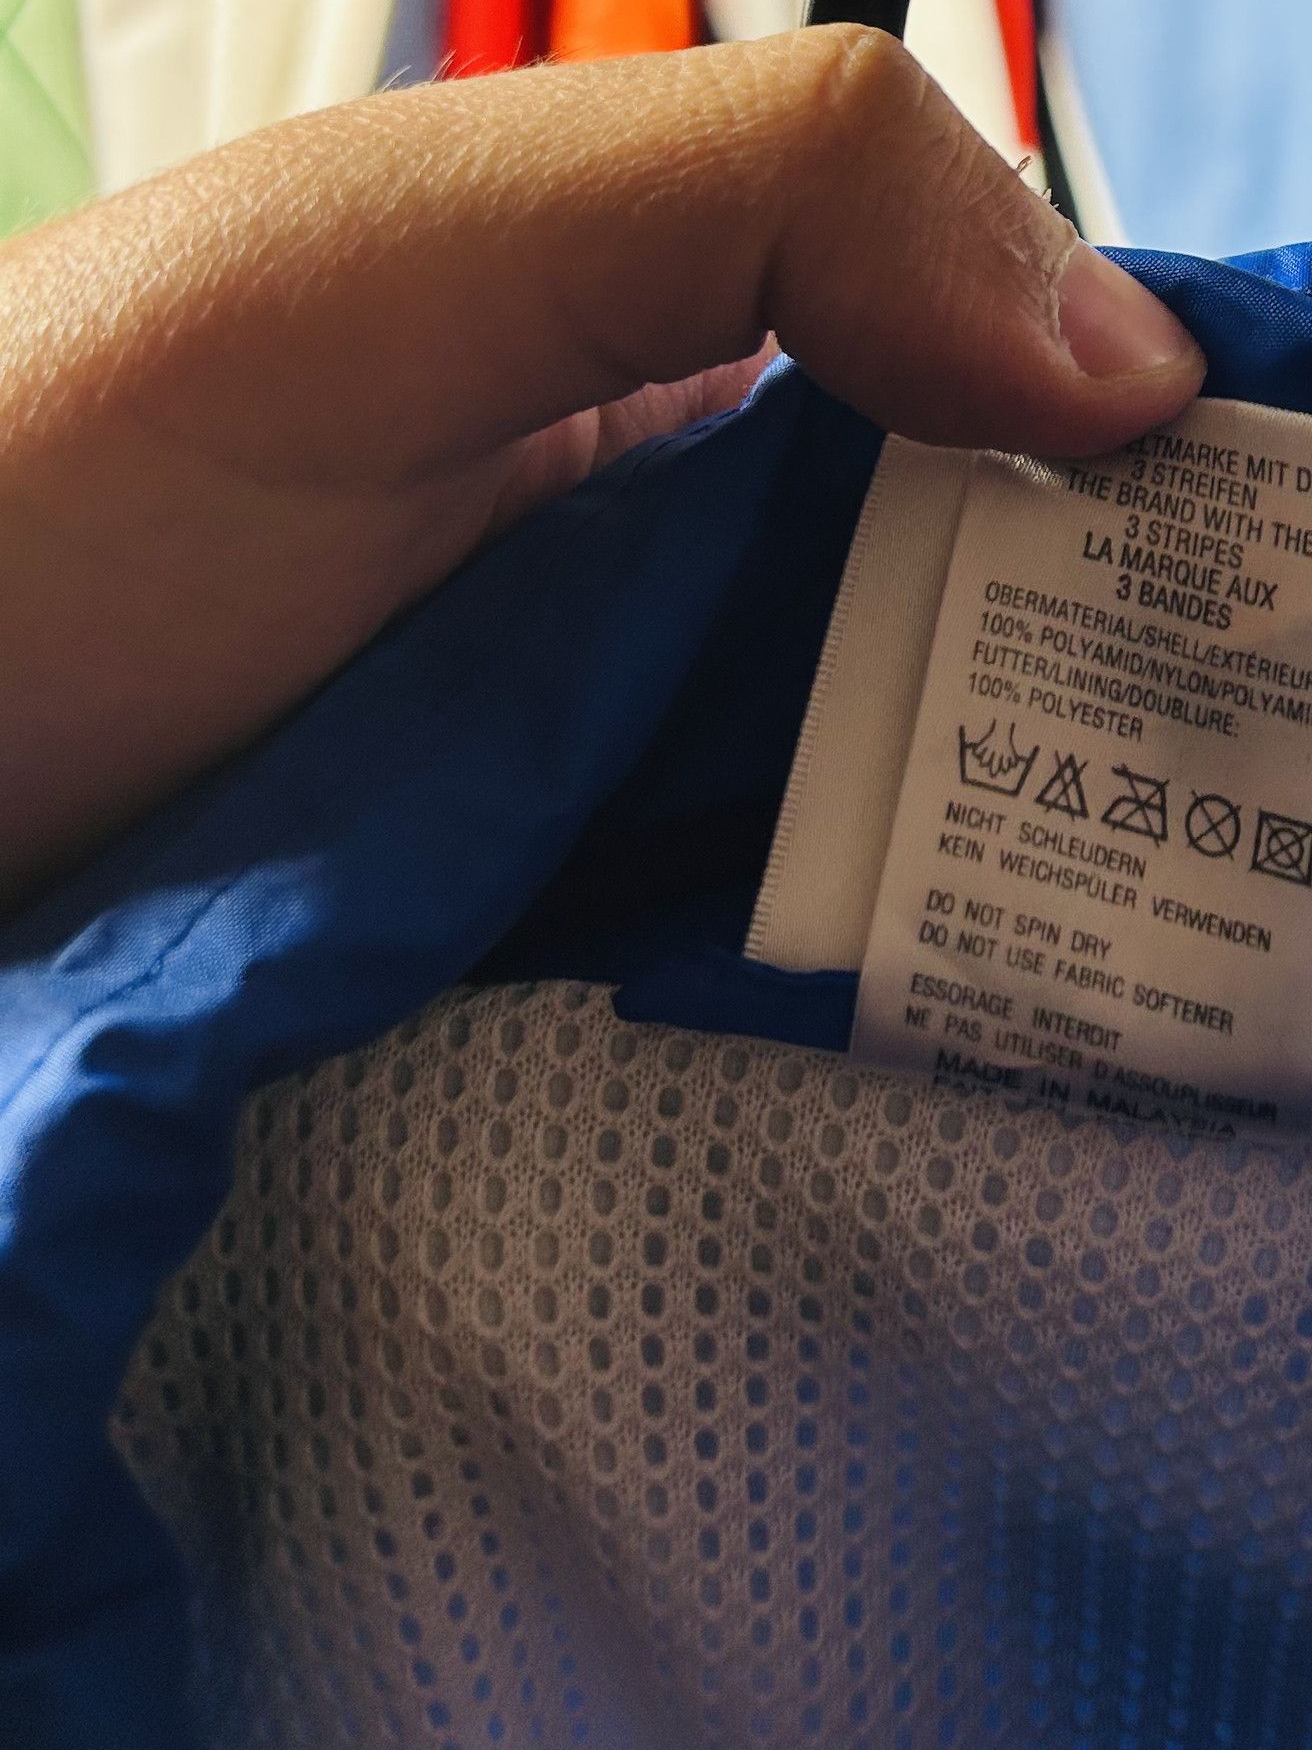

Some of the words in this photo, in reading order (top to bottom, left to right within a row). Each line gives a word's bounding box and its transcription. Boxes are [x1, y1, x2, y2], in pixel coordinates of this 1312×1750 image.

[1126, 435, 1239, 475] LTMARKE
[1246, 454, 1288, 486] MIT
[1131, 460, 1147, 481] 3
[1151, 461, 1257, 510] STREIFEN
[1068, 468, 1111, 501] THE
[1116, 484, 1196, 523] BRAND
[1204, 505, 1263, 542] WITH
[1083, 531, 1113, 565] LA
[1118, 543, 1222, 595] MARQUE
[1227, 578, 1279, 611] AUX
[1125, 514, 1139, 539] 3
[1146, 519, 1244, 569] STRIPES
[980, 611, 1033, 643] 100%
[1116, 573, 1131, 600] 3
[1138, 580, 1232, 631] BANDES
[968, 671, 1021, 704] 100%
[1028, 686, 1143, 743] POLYESTER
[972, 640, 1239, 738] FUTTER/LINING/DOUBLURE:
[945, 801, 1006, 833] NICHT
[1018, 822, 1147, 880] SCHLEUDERN
[926, 889, 955, 916] DO
[965, 900, 1004, 928] NOT
[1014, 914, 1061, 946] SPIN
[1071, 930, 1112, 962] DRY
[939, 833, 985, 864] KEIN
[1000, 850, 1137, 909] WEICHSPÜLER
[1152, 896, 1272, 953] VERWENDEN
[911, 973, 1012, 1020] ESSORAGE
[1033, 1008, 1123, 1051] INTERDIT
[919, 920, 948, 947] DO
[957, 931, 998, 959] NOT
[1006, 947, 1043, 975] USE
[1054, 959, 1125, 999] FABRIC
[1133, 984, 1234, 1035] SOFTENER
[905, 1007, 931, 1031] NE
[944, 1014, 983, 1043] PAS
[995, 1030, 1082, 1070] UTILISER
[937, 1049, 1023, 1090] MADE
[1040, 1074, 1070, 1102] IN
